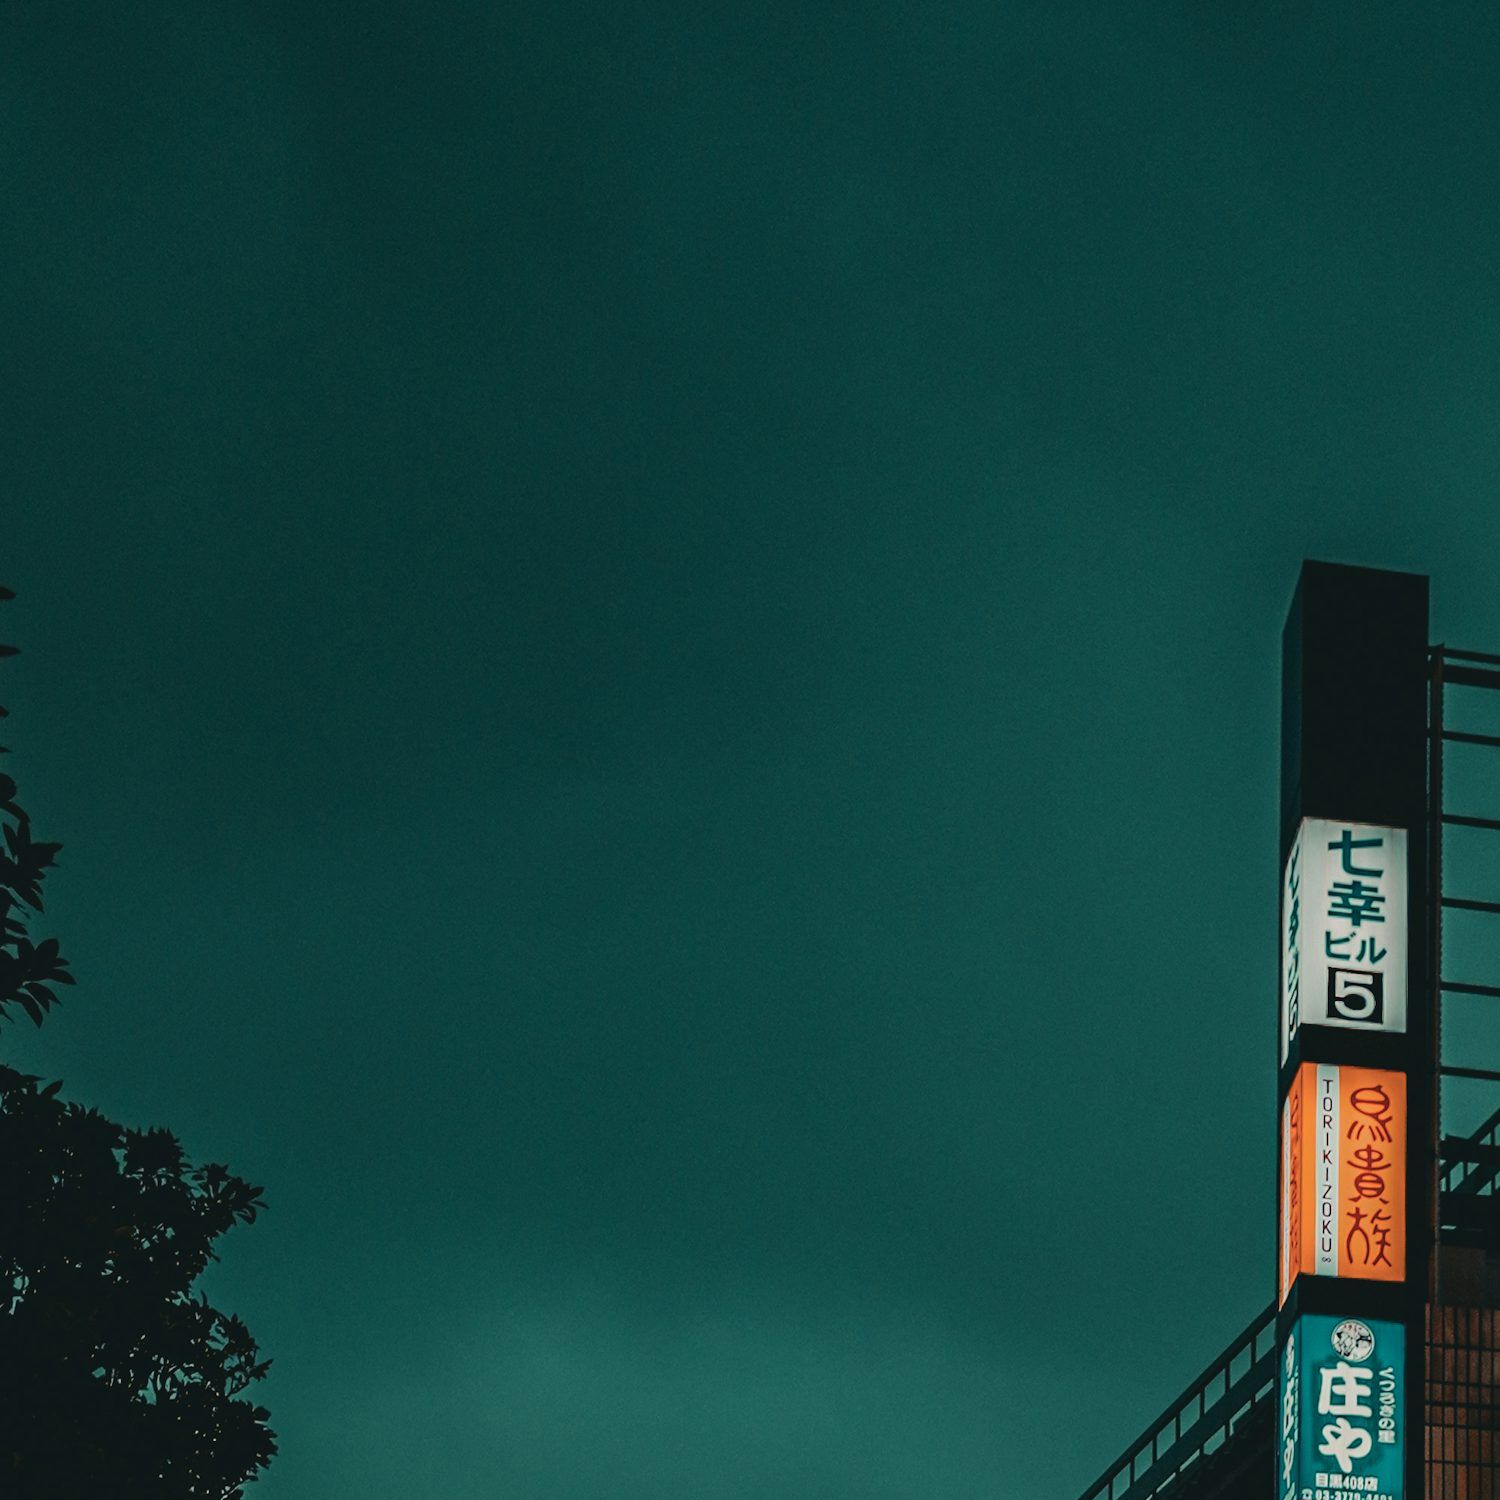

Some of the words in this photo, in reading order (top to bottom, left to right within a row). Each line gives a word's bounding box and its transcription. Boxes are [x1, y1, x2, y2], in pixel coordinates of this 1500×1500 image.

[1323, 829, 1388, 965] 七幸ビル
[1333, 972, 1377, 1020] 5
[1322, 1079, 1334, 1253] TORIKIZOKU
[1346, 1085, 1394, 1268] 鳥貴族
[1318, 1361, 1374, 1473] 庄や
